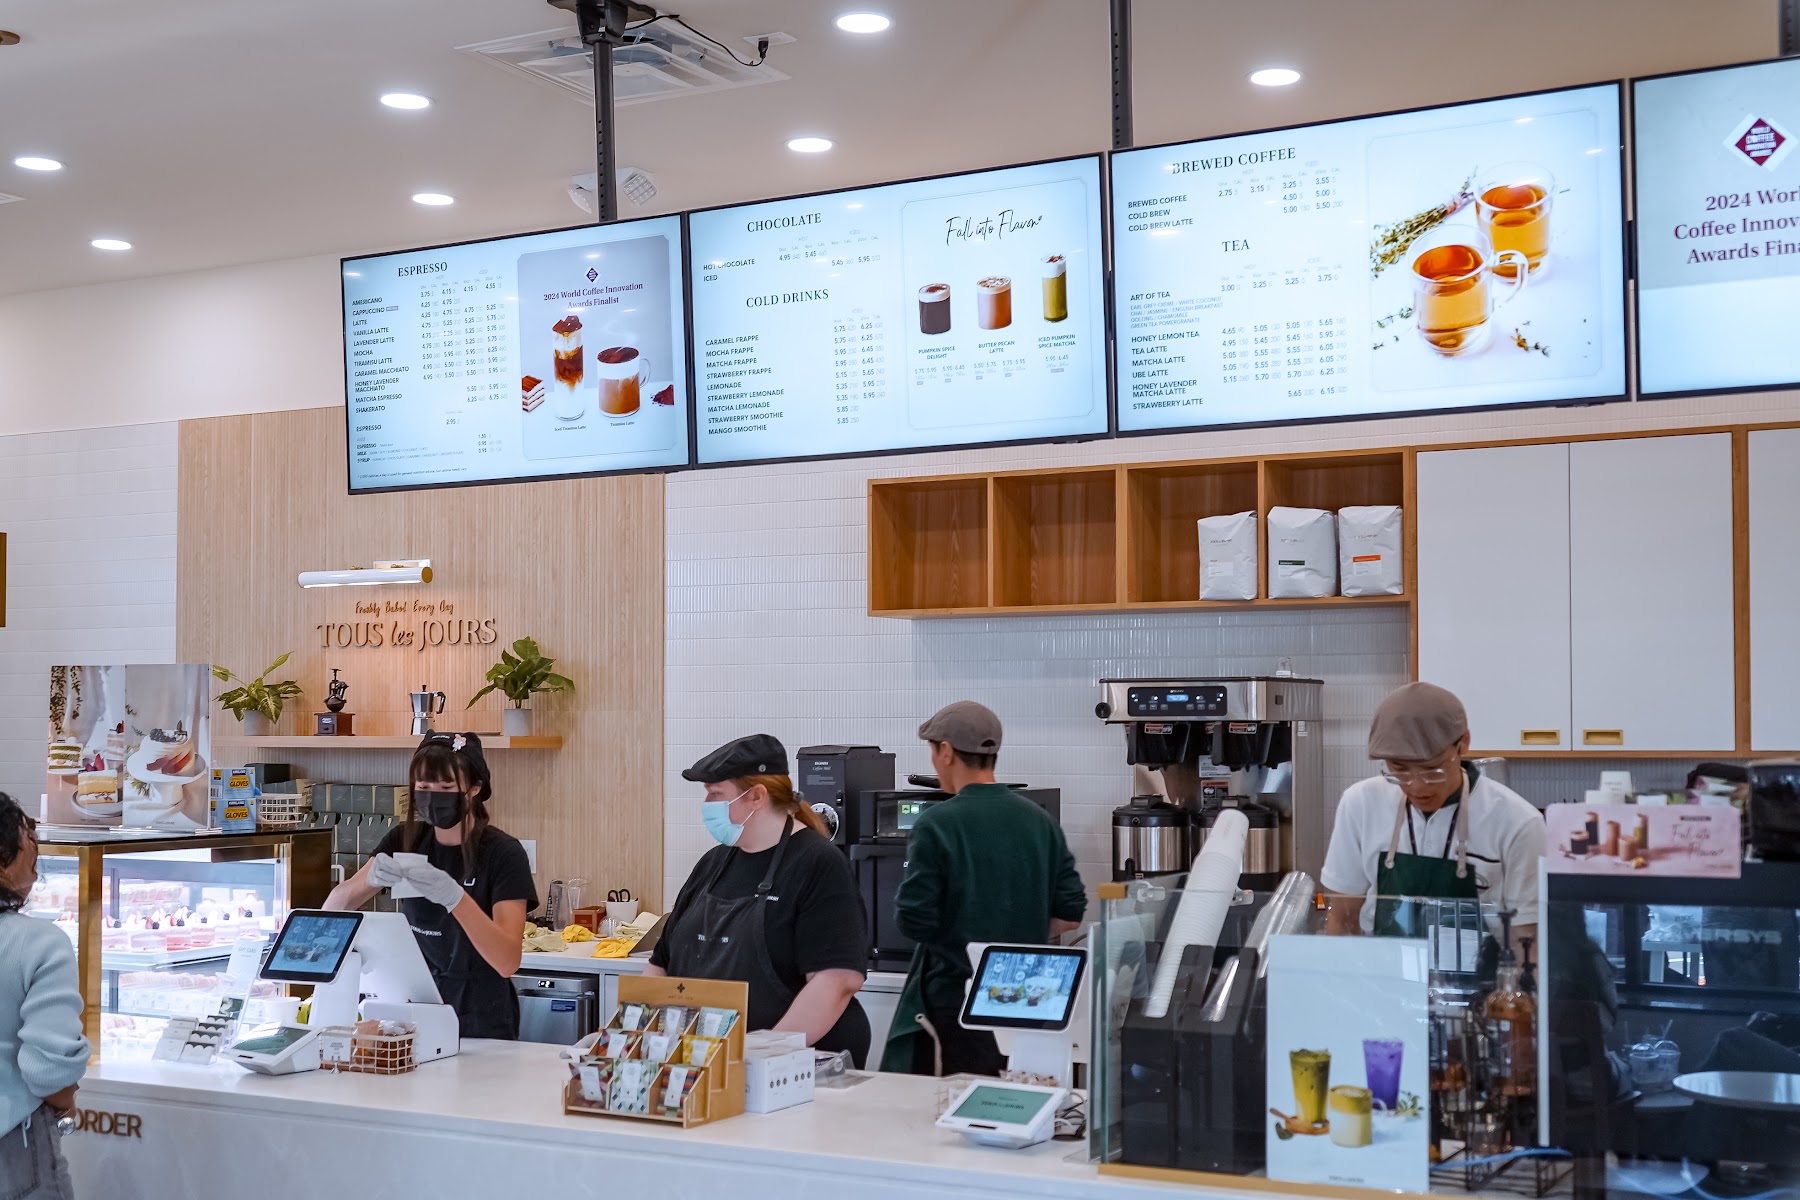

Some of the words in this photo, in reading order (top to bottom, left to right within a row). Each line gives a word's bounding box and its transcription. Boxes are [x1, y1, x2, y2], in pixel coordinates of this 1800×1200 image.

[1172, 156, 1233, 174] BREWED
[1239, 148, 1296, 166] COFFEE
[1219, 189, 1233, 197] 2.75
[1251, 185, 1264, 193] 3.15
[1283, 181, 1297, 189] 3.25
[1316, 177, 1330, 185] 3.55
[1128, 198, 1158, 208] BREWED
[1160, 195, 1187, 205] COFFEE
[1283, 193, 1298, 202] 4.50
[1316, 189, 1330, 198] 5.00
[1705, 192, 1751, 211] 2024
[1284, 206, 1298, 214] 5.00
[1316, 202, 1330, 210] 5.50
[1128, 212, 1148, 220] COLD
[1150, 209, 1171, 217] BREW
[748, 213, 821, 233] CHOCOLATE
[946, 216, 973, 246] Fall
[976, 217, 994, 241] into
[999, 209, 1043, 240] Flavor
[1129, 224, 1148, 232] COLD
[1150, 221, 1171, 230] BREW
[1172, 218, 1194, 227] LATTE
[1674, 221, 1736, 240] Coffee
[1222, 239, 1250, 252] TEA
[1687, 243, 1759, 264] Awards
[398, 261, 448, 278] ESPRESSO
[703, 263, 716, 271] HOT
[718, 259, 755, 269] CHOCOLATE
[544, 293, 559, 301] 2024
[560, 290, 581, 299] World
[582, 287, 604, 296] Coffee
[605, 283, 643, 294] Innovation
[352, 297, 383, 306] AMERICANO
[568, 299, 592, 308] Awards
[594, 297, 619, 306] Finalist
[747, 295, 778, 308] COLD
[783, 289, 829, 304] DRINKS
[353, 307, 385, 316] CAPPUCCINO
[354, 338, 379, 347] LAVENDER
[706, 338, 734, 346] CARAMEL
[736, 335, 759, 343] FRAPPE
[1132, 335, 1157, 343] HONEY
[1158, 333, 1184, 341] LEMON
[706, 349, 730, 357] MOCHA
[731, 347, 754, 355] FRAPPE
[1147, 346, 1168, 354] LATTE
[355, 359, 377, 367] TIRAMISU
[707, 360, 733, 368] MATCHA
[734, 358, 757, 366] FRAPPE
[1132, 358, 1162, 367] MATCHA
[1165, 356, 1185, 364] LATTE
[707, 370, 747, 379] STRAWBERRY
[355, 385, 385, 393] MACCHIATO
[707, 382, 741, 391] LEMONADE
[1133, 383, 1158, 391] HONEY
[1160, 380, 1197, 389] LAVENDER
[708, 392, 748, 402] STRAWBERRY
[750, 389, 784, 398] LEMONADE
[1133, 390, 1163, 398] MATCHA
[356, 406, 385, 414] SHAKERATO
[708, 405, 734, 413] MATCHA
[736, 402, 770, 411] LEMONADE
[1133, 400, 1180, 410] STRAWBERRY
[1183, 398, 1203, 406] LATTE
[709, 415, 749, 424] STRAWBERRY
[750, 412, 783, 420] SMOOTHIE
[734, 424, 767, 433] SMOOTHIE
[386, 601, 406, 613] Baked
[413, 600, 435, 616] Every
[440, 600, 454, 615] Day
[317, 622, 383, 648] TOUS
[392, 620, 414, 646] les
[419, 618, 497, 652] JOURS
